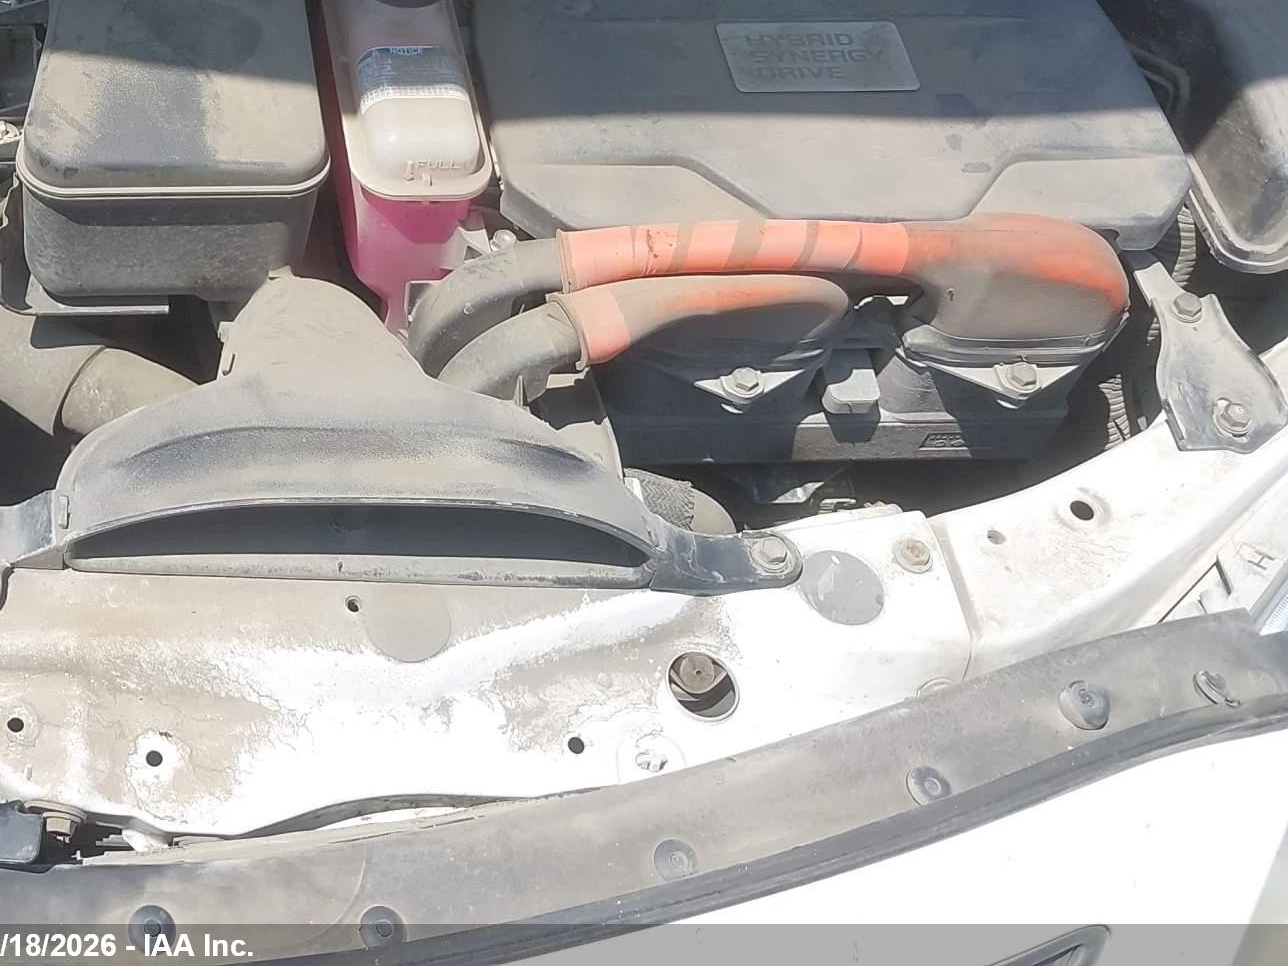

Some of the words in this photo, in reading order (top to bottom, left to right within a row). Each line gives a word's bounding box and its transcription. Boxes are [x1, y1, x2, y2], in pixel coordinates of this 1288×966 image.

[745, 33, 853, 46] HYBRID
[750, 49, 883, 63] SYNERGY
[756, 66, 846, 80] DRIVE
[416, 161, 464, 171] FULL
